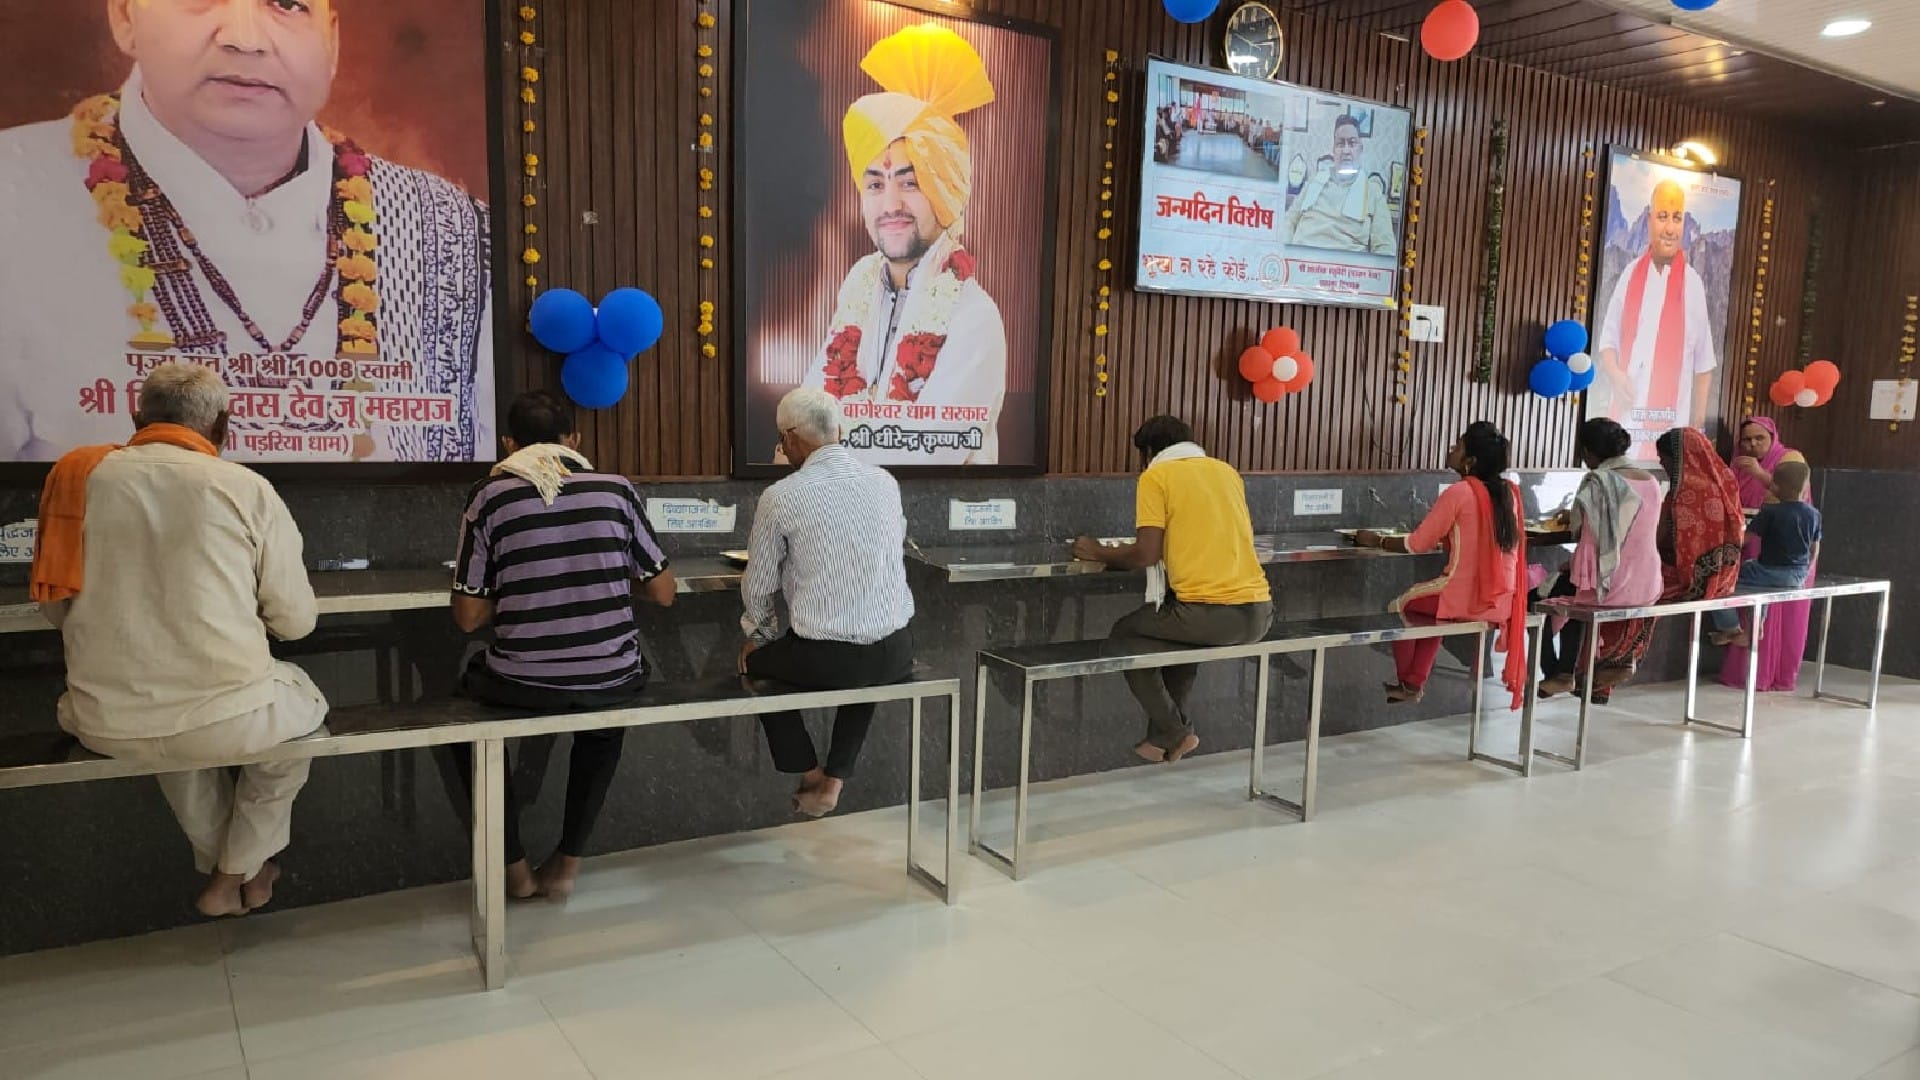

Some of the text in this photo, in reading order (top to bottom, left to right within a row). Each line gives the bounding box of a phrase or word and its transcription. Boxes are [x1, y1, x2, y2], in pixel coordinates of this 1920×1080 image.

[1156, 191, 1274, 229] जन्मदिन विशेष
[1179, 256, 1194, 277] न
[1197, 254, 1216, 279] रहे
[228, 352, 253, 374] श्री
[261, 353, 287, 376] श्री
[296, 359, 354, 378] 1008
[360, 359, 414, 380] स्वामी
[79, 378, 116, 413] श्री
[289, 385, 325, 419] देव
[332, 395, 358, 428] जू
[365, 396, 452, 422] महाराज
[843, 400, 988, 421] बागेश्वर धाम सरकार
[244, 430, 303, 455] पड़रिया
[850, 424, 982, 454] श्री धीरेन्द्र कृष्ण जी
